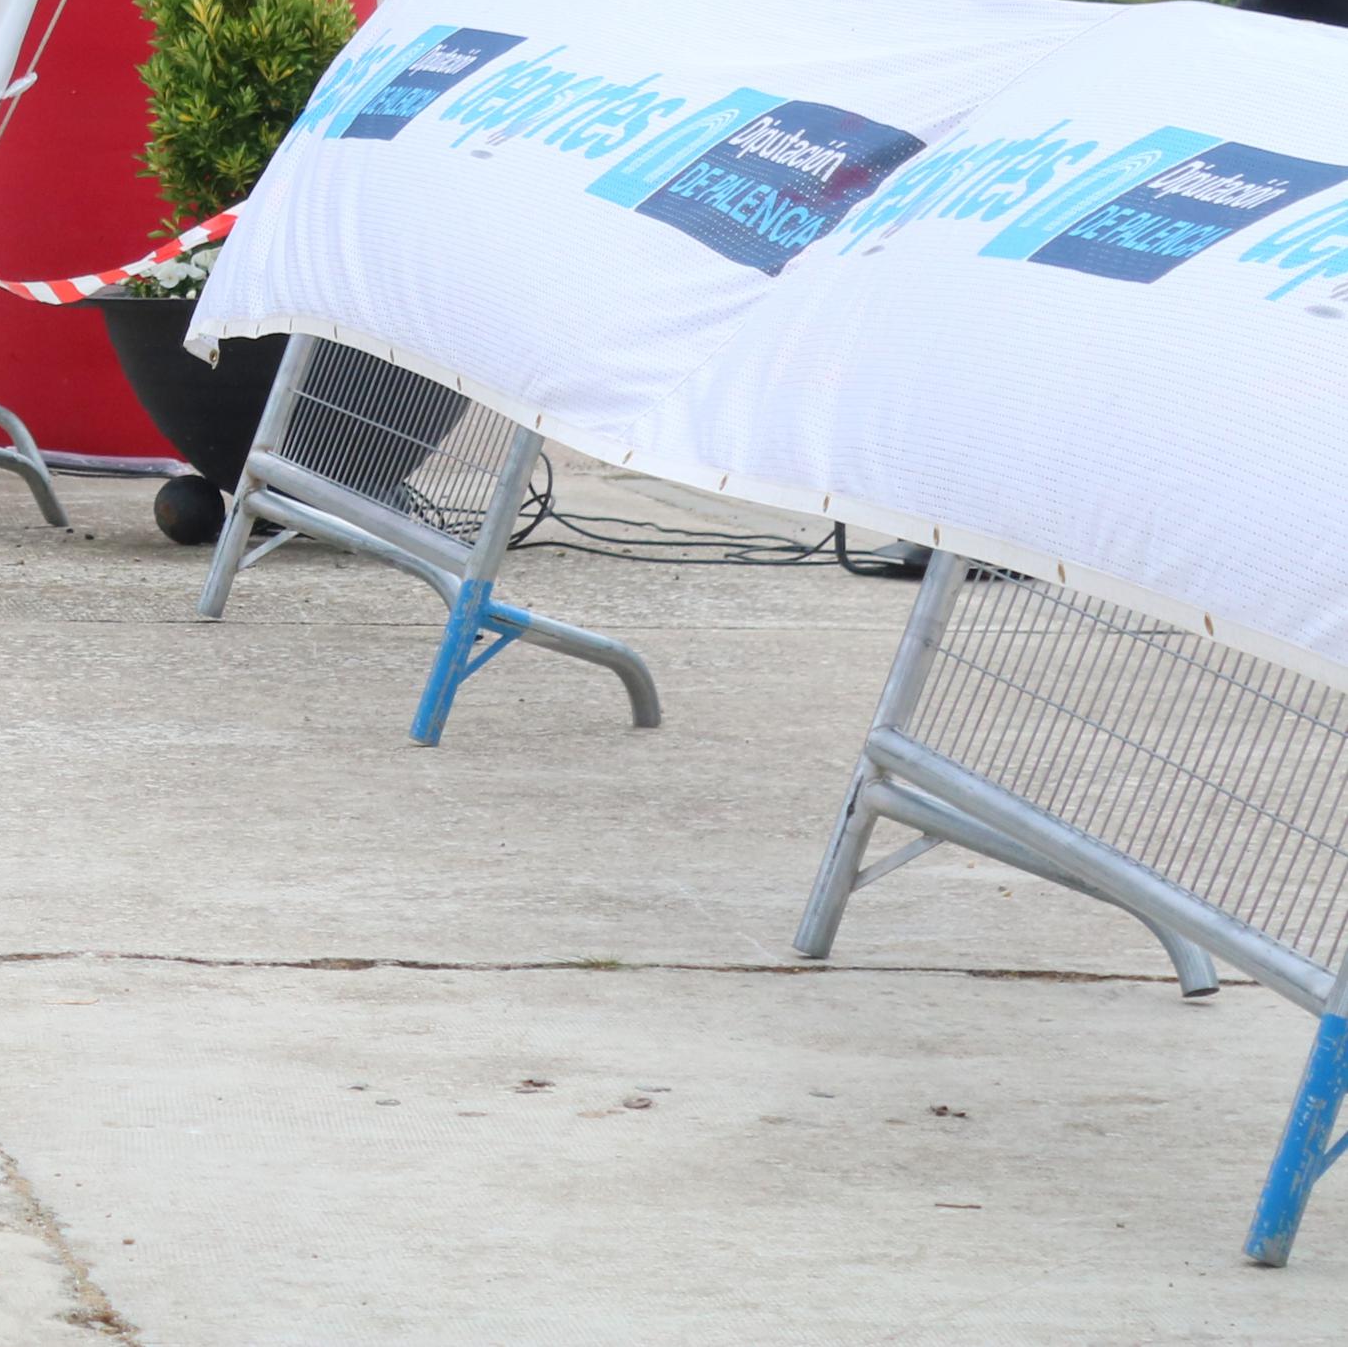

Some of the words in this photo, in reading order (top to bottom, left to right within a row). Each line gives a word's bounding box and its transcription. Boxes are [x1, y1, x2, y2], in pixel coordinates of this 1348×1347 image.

[440, 44, 687, 160] deportes
[728, 116, 848, 182] Diputación
[668, 162, 724, 198] DE
[1146, 160, 1290, 210] Diputación
[693, 172, 826, 249] PALENCIA
[1067, 205, 1136, 239] DE
[1097, 211, 1234, 258] PALENCIA
